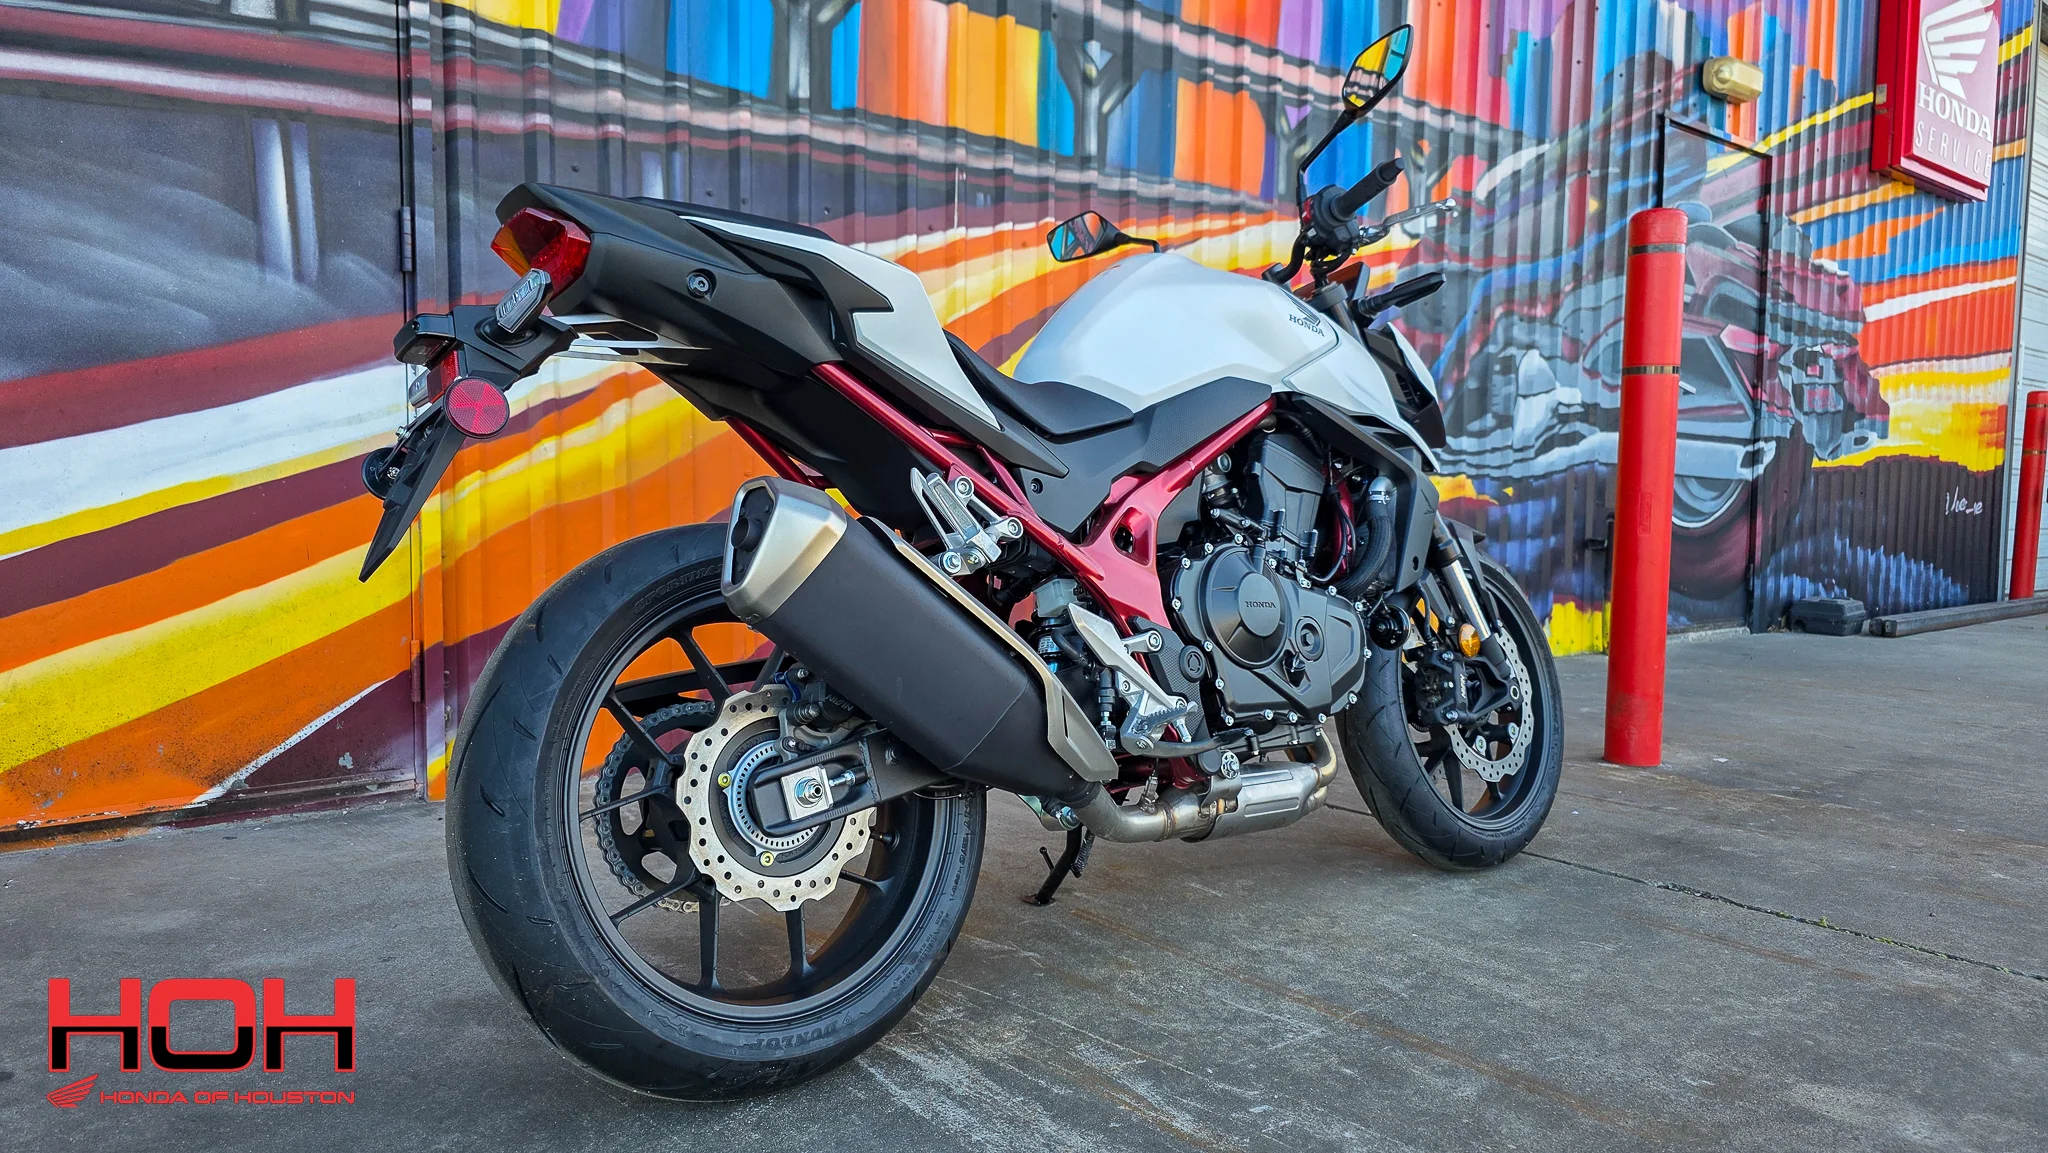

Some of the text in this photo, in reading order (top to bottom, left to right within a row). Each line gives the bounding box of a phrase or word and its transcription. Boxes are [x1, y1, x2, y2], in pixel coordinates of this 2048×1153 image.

[1917, 81, 1993, 144] HONDA
[1915, 120, 1992, 179] SERVICE
[1288, 313, 1326, 337] HONDA
[1245, 601, 1277, 609] HONDA
